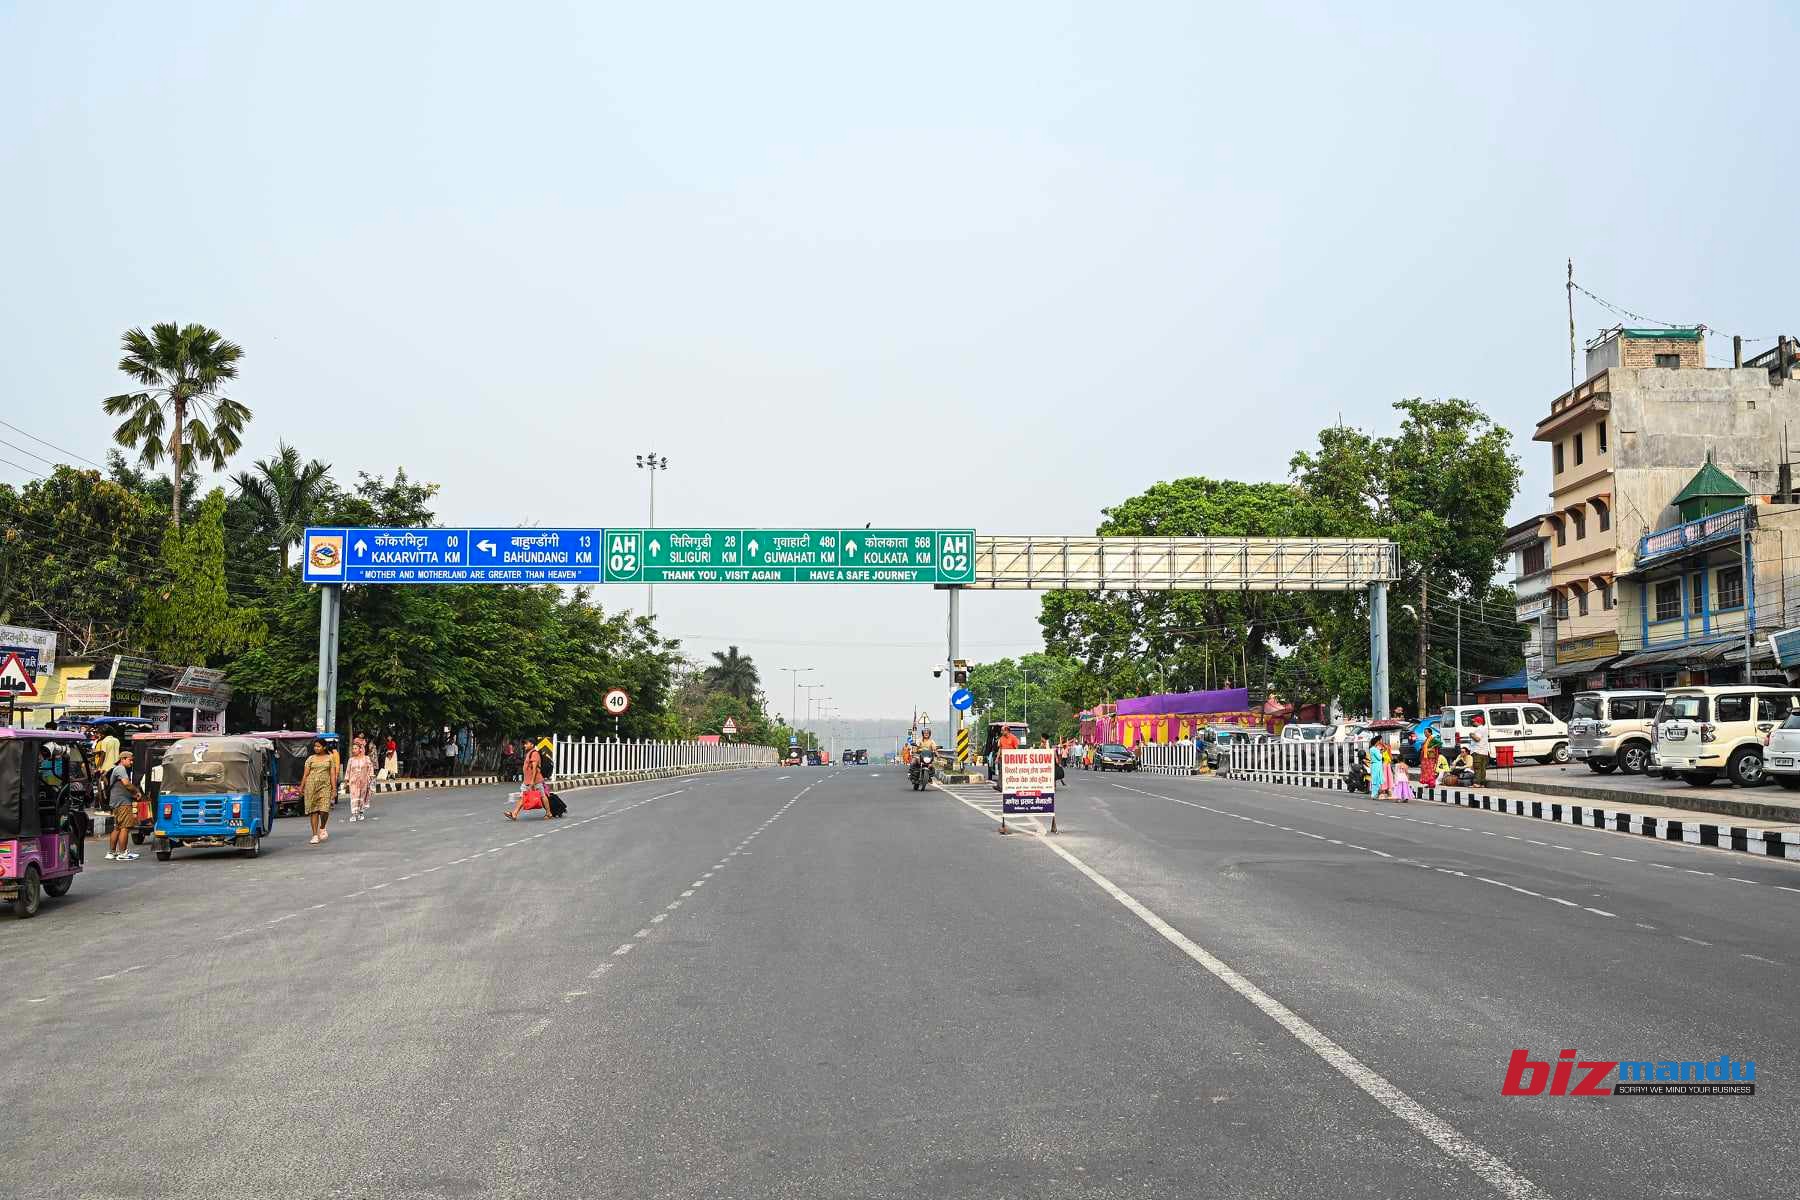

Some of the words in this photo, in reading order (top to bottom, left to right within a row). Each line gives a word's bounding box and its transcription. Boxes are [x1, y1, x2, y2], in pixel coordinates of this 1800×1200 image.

[447, 535, 459, 548] 00
[579, 535, 591, 548] 13
[611, 535, 636, 554] AH
[724, 535, 736, 548] 28
[772, 532, 811, 550] गुवाहाटी
[819, 535, 835, 548] 480
[864, 533, 909, 549] कोलकाता
[914, 536, 931, 549] 568
[942, 536, 967, 554] AH
[371, 551, 439, 564] KAKARVITTA
[444, 551, 461, 564] KM
[503, 551, 569, 564] BAHUNDANGI
[575, 551, 592, 564] KM
[610, 554, 636, 572] 02
[669, 551, 711, 563] SILIGURI
[721, 551, 737, 563] KM
[763, 551, 816, 563] GUWAHATI
[820, 551, 835, 563] KM
[863, 552, 909, 564] KOLKATA
[915, 552, 931, 564] KM
[942, 554, 968, 572] 02
[399, 570, 415, 579] AND
[417, 570, 467, 579] MOTHERLAND
[470, 570, 485, 579] ARE
[488, 570, 522, 579] GREATER
[525, 570, 544, 579] THAN
[662, 570, 695, 580] THANK
[725, 570, 749, 580] VISIT
[751, 570, 781, 580] AGAIN
[809, 570, 835, 580] HAVE
[836, 570, 844, 580] A
[846, 570, 870, 580] SAFE
[872, 570, 918, 580] JOURNEY
[609, 696, 624, 707] 40
[1004, 753, 1028, 764] DRIVE
[1029, 753, 1053, 764] SLOW
